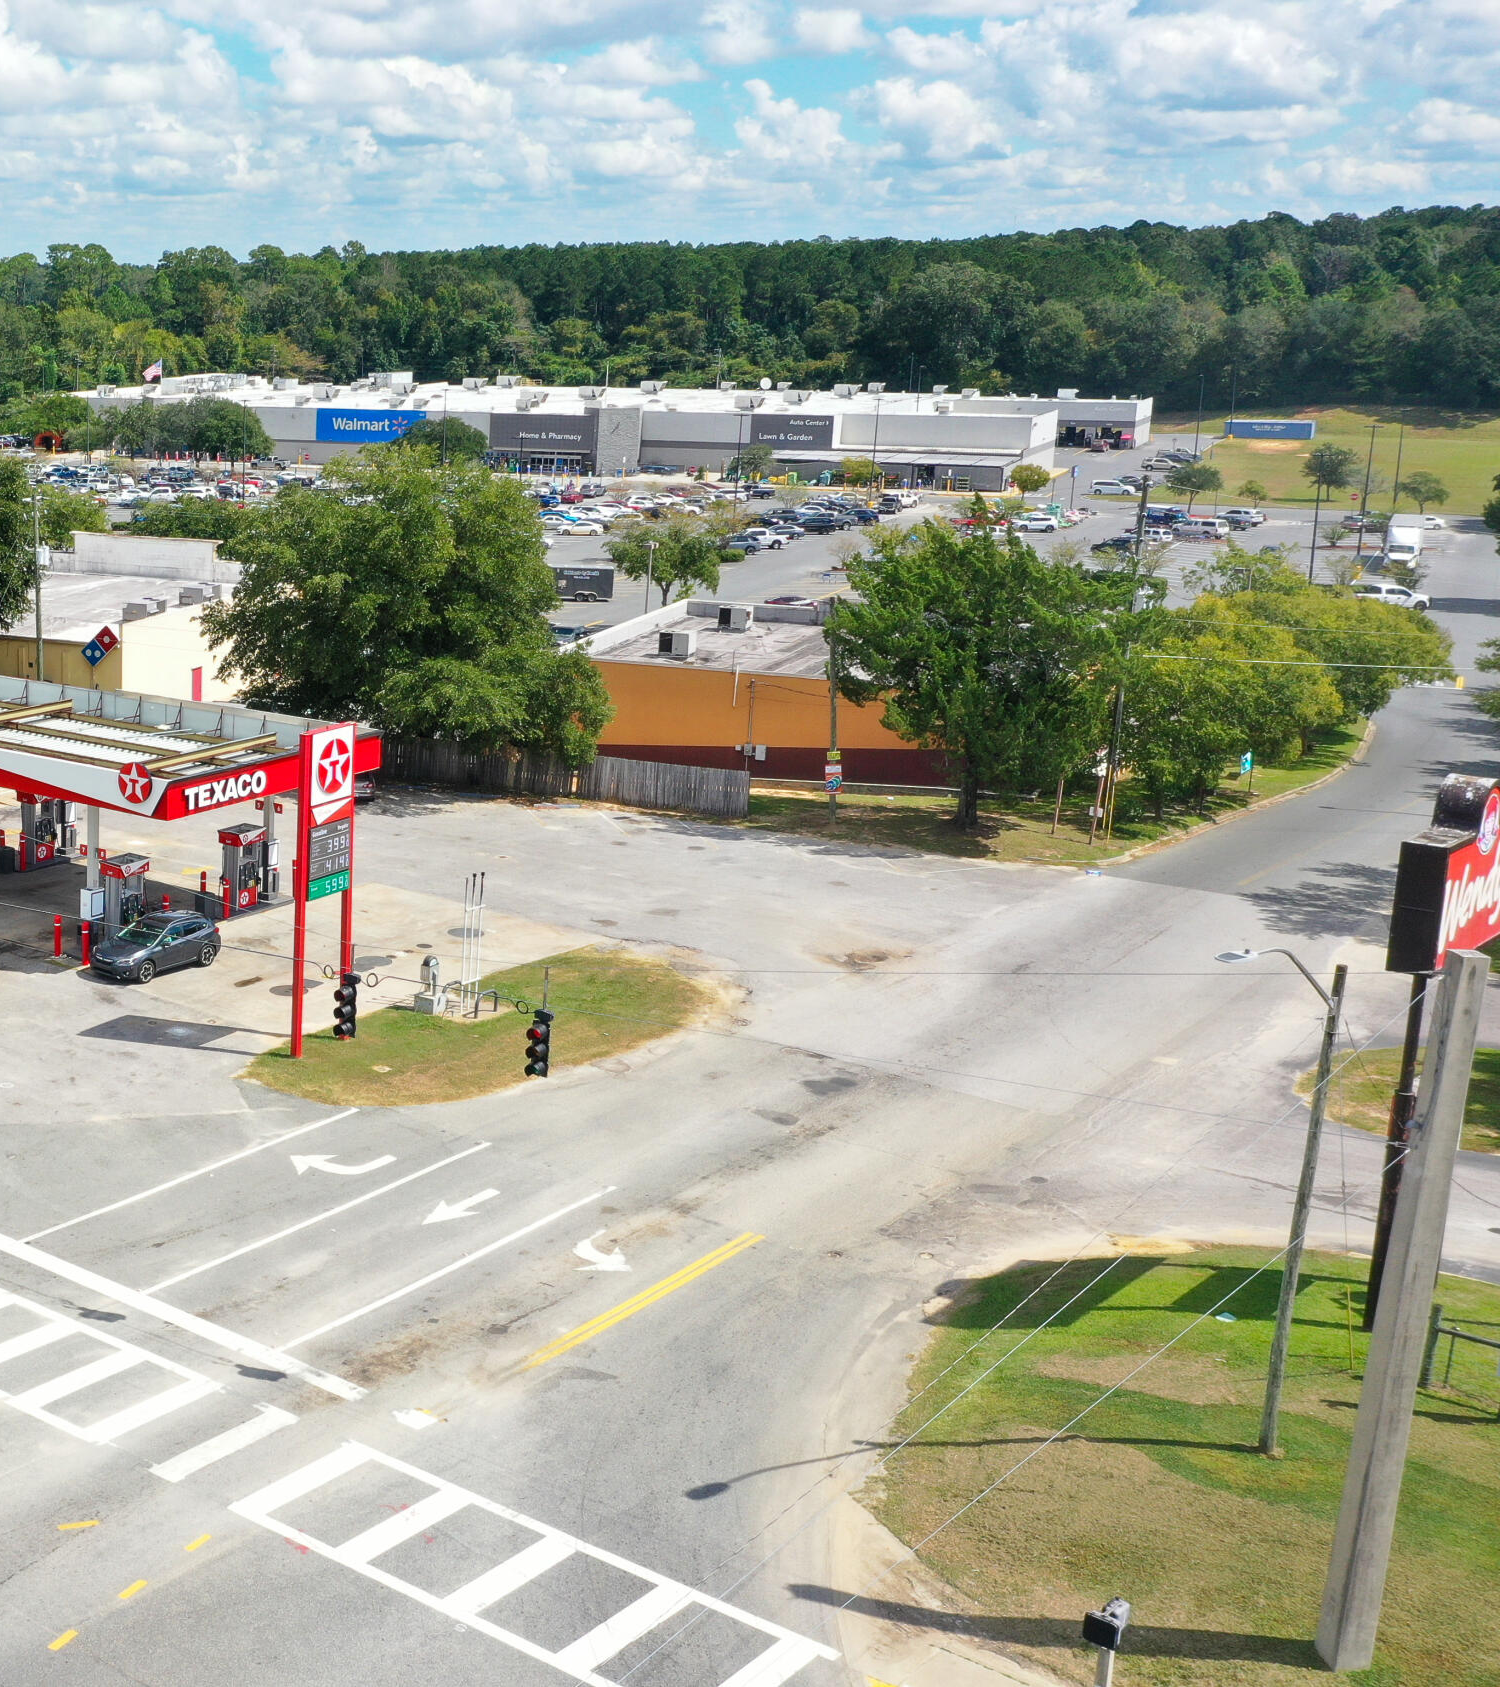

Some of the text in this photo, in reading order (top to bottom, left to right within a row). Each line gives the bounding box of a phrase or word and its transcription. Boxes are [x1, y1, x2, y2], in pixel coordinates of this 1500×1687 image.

[332, 417, 390, 431] Walmart
[519, 431, 539, 439] Home
[548, 432, 581, 442] Pharmacy
[787, 433, 813, 441] Garden
[184, 770, 267, 811] TEXACO
